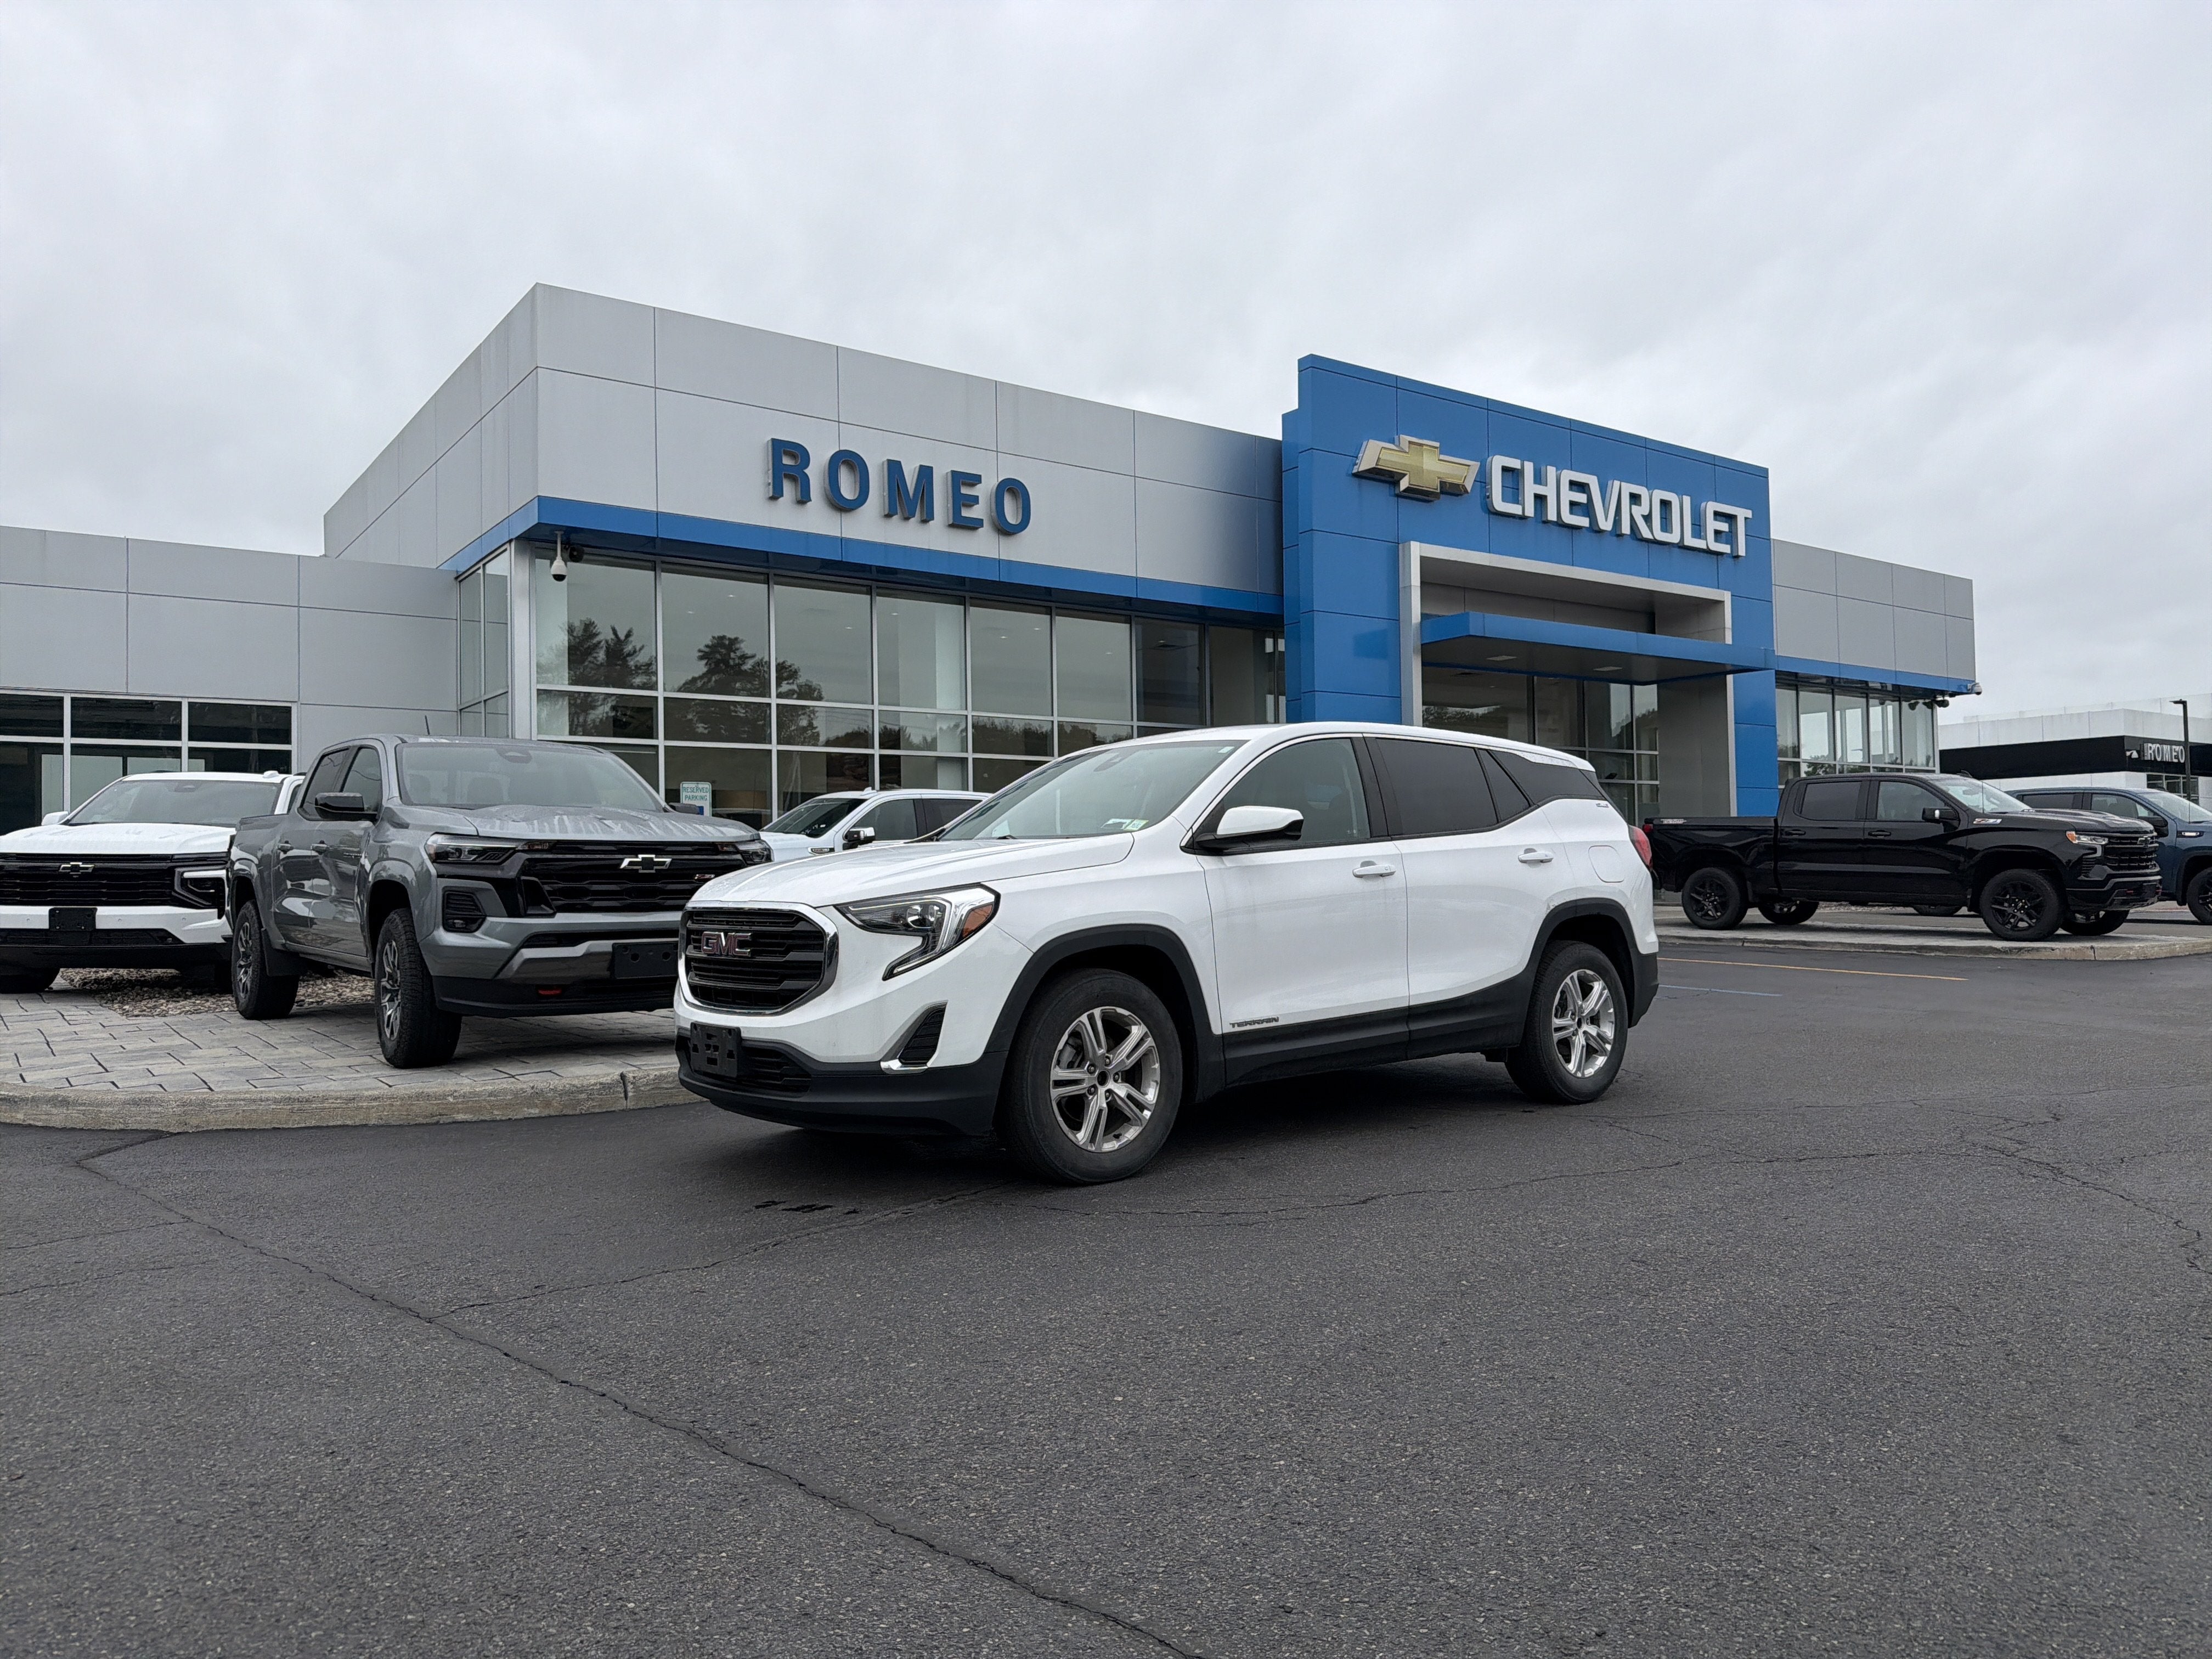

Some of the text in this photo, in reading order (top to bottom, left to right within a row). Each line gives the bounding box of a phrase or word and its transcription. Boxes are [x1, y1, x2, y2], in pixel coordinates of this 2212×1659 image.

[769, 438, 1031, 535] ROMEO
[1486, 455, 1752, 557] CHEVROLET
[2144, 743, 2185, 763] ROMEO
[701, 932, 752, 956] GMC
[1229, 1017, 1279, 1029] TERRAIN
